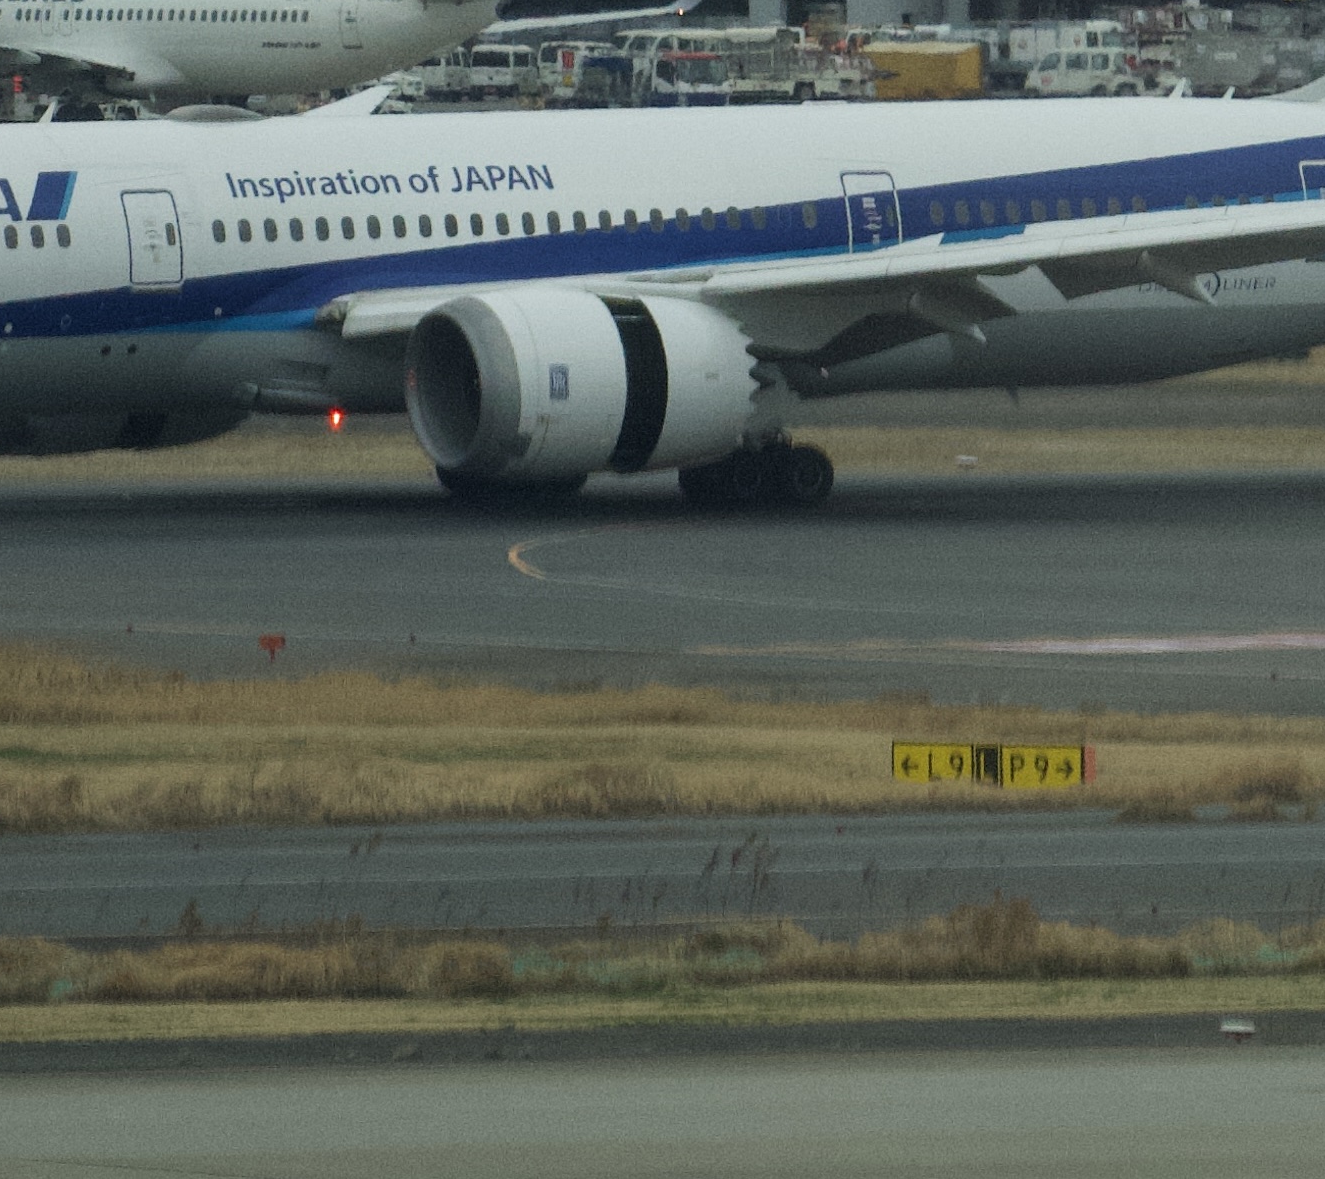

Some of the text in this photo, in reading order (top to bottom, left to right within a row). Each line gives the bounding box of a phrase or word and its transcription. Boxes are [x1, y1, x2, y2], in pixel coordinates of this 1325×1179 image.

[225, 162, 556, 204] Inspiration of JAPAN
[928, 751, 965, 781] L9
[1010, 753, 1050, 784] P9
